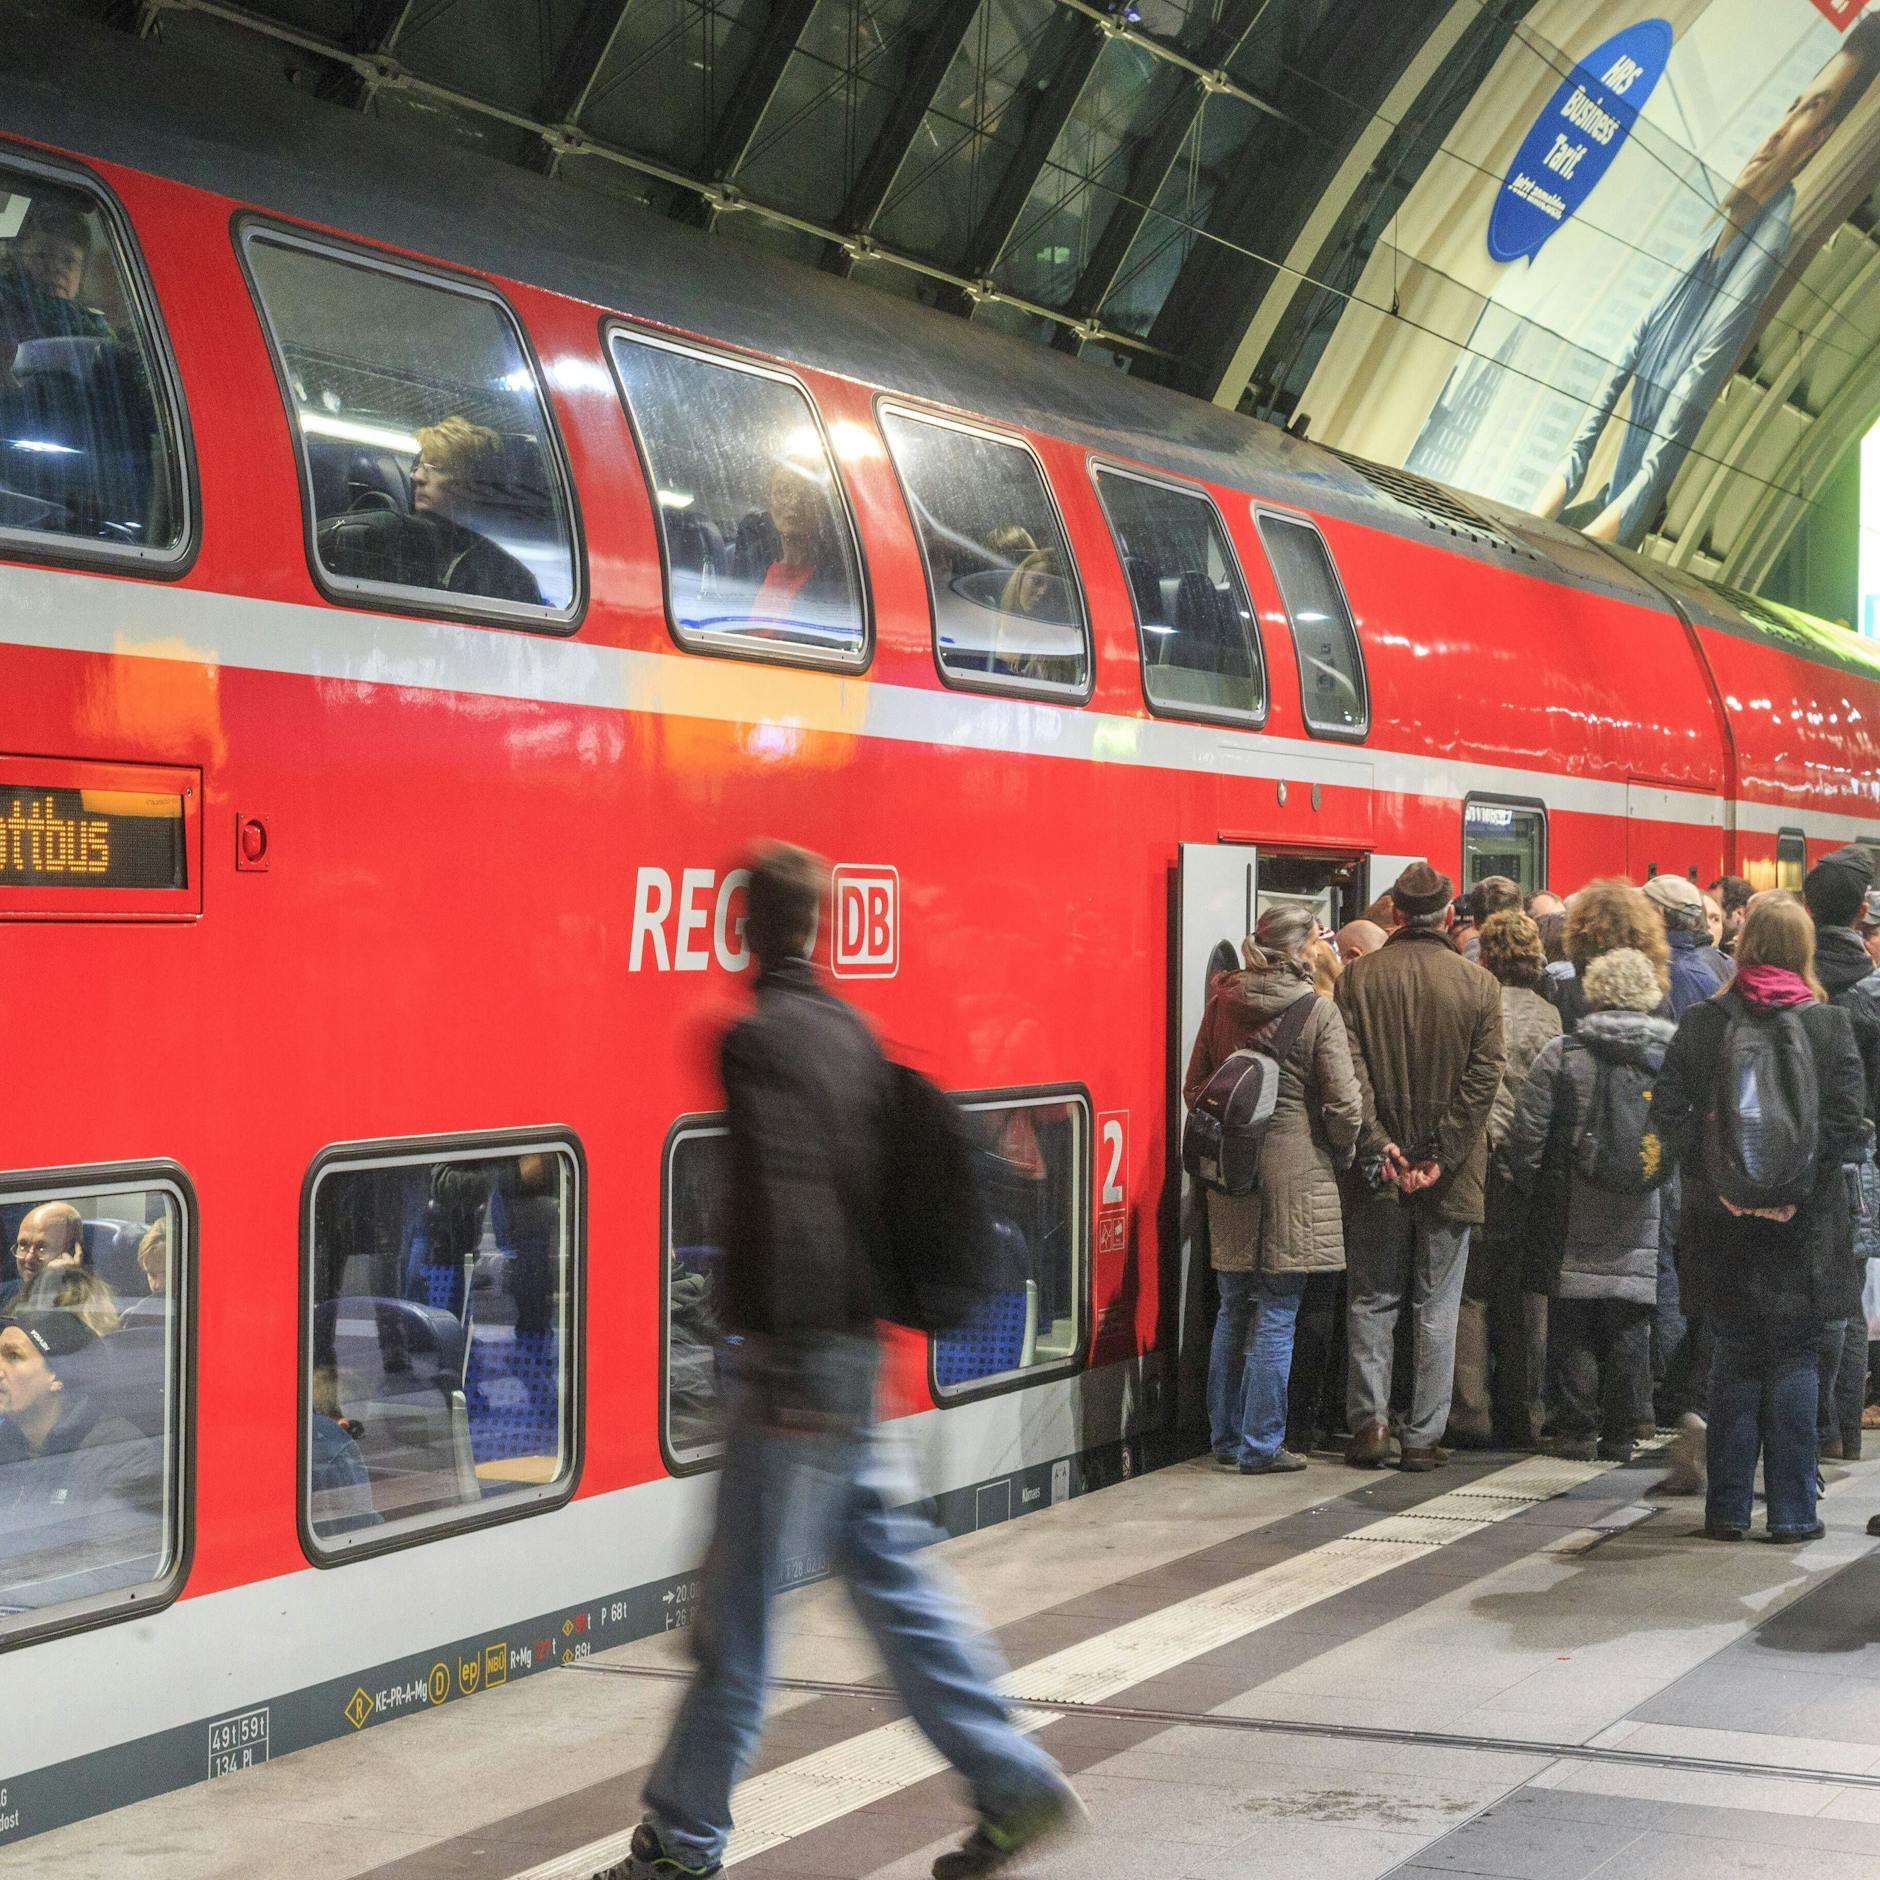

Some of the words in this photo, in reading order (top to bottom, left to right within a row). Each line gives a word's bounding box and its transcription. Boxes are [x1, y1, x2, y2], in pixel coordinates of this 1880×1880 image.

[1601, 54, 1644, 95] HRS
[1560, 84, 1621, 145] Business
[1543, 133, 1588, 180] Tarif.
[1508, 172, 1536, 199] Jetzt
[837, 877, 894, 964] DB
[1102, 1119, 1123, 1204] 2
[601, 1607, 607, 1626] P
[375, 1679, 428, 1713] KE-PR-A-Mg
[462, 1662, 477, 1686] ep
[216, 1752, 237, 1777] 134
